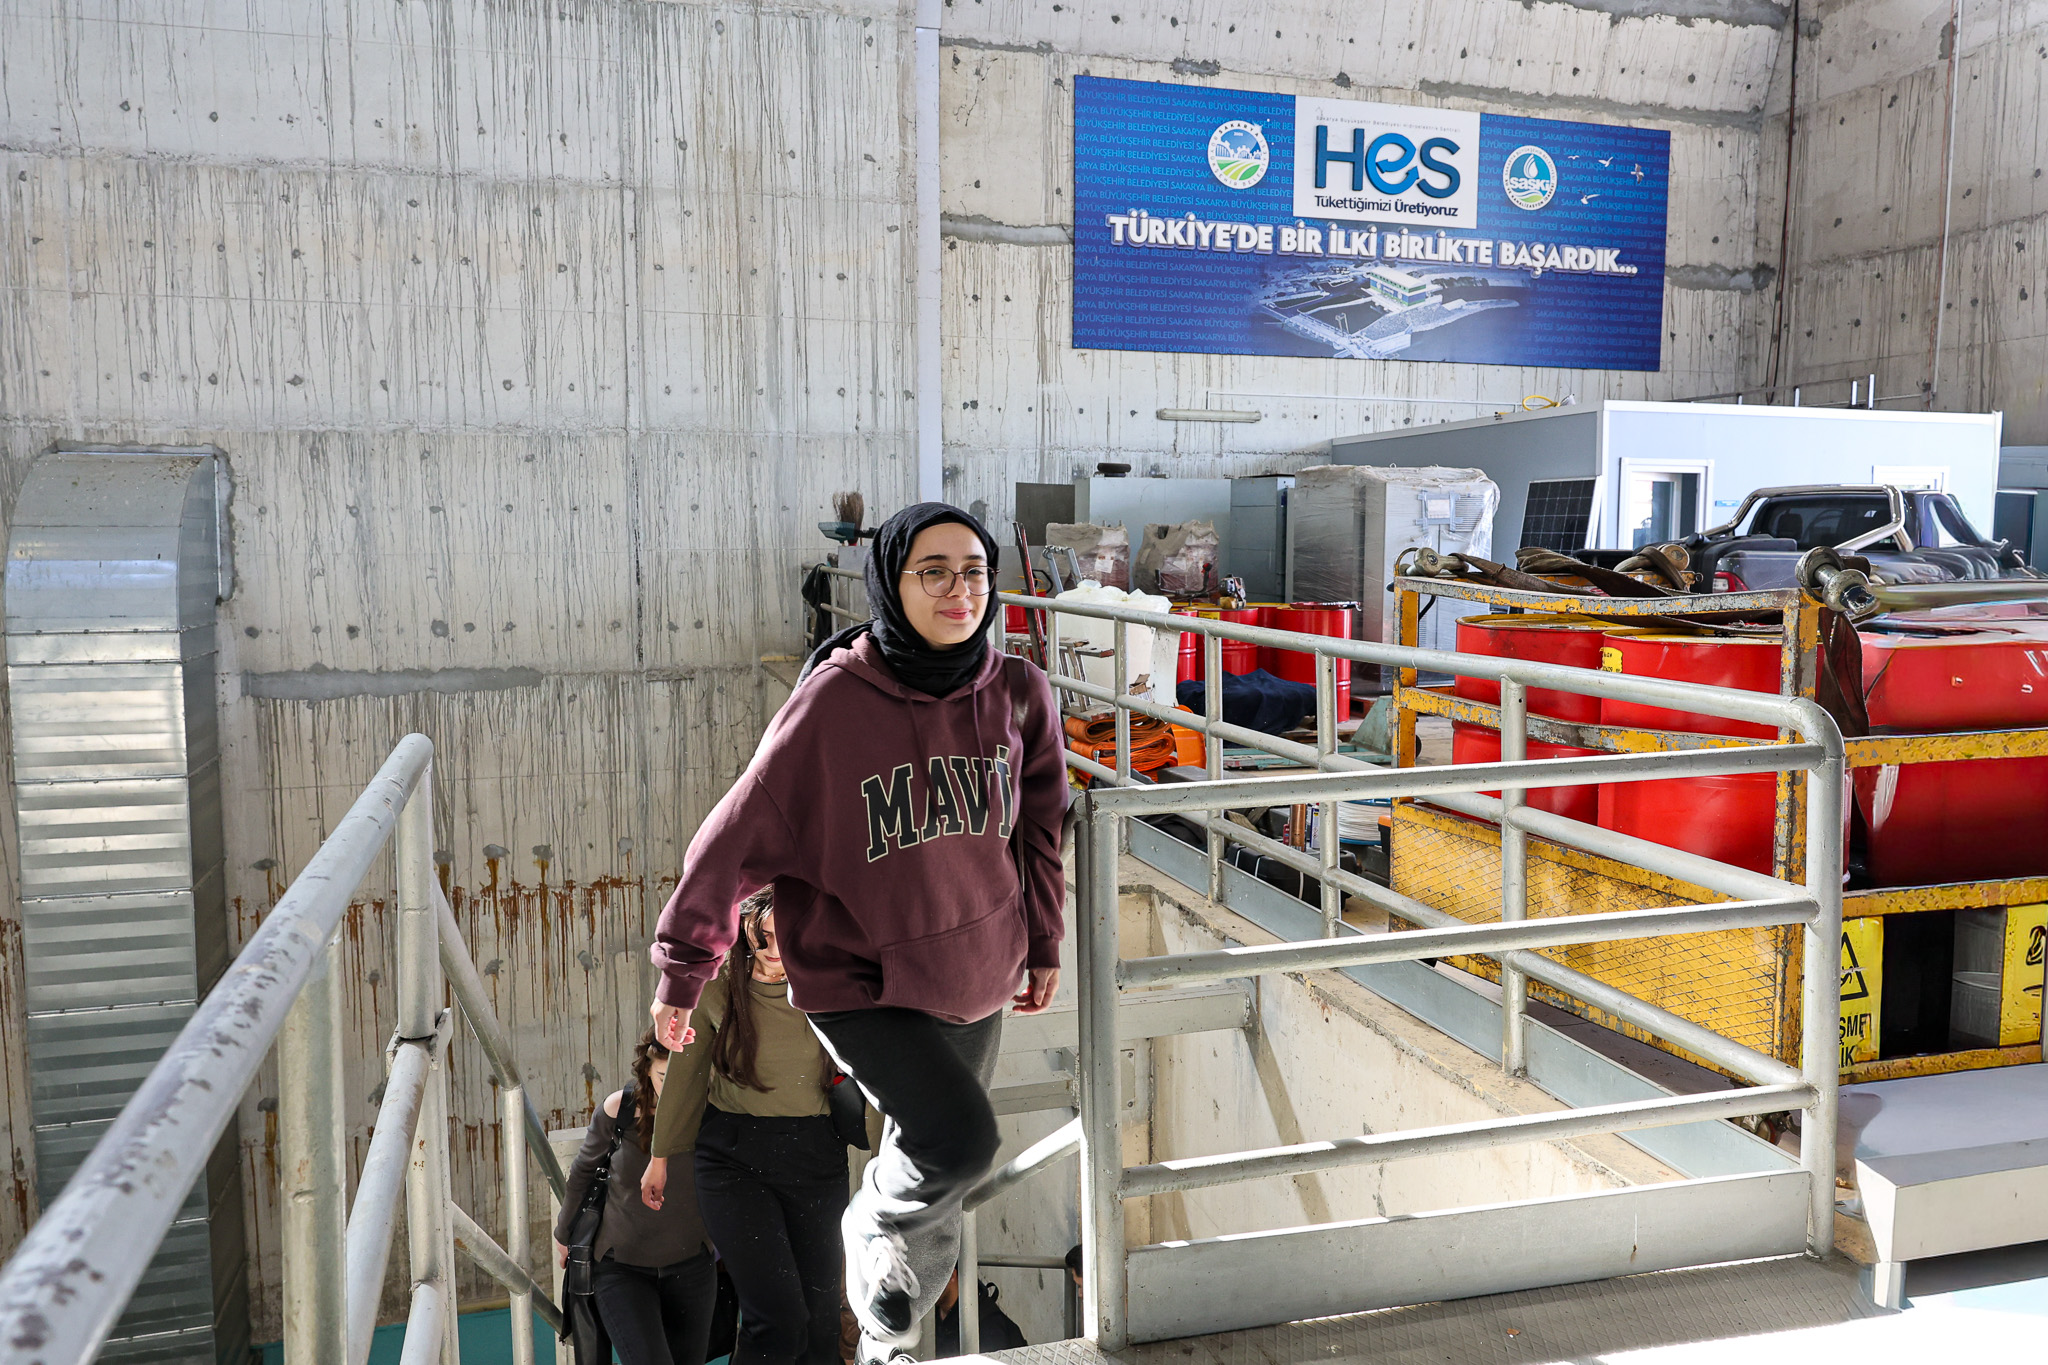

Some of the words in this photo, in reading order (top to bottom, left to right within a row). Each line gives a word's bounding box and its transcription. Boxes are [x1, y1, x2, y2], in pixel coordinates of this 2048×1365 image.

[1172, 98, 1206, 108] SAKARYA
[1172, 126, 1206, 136] SAKARYA
[1171, 153, 1205, 164] SAKARYA
[1171, 181, 1205, 191] SAKARYA
[1195, 197, 1229, 207] SAKARYA
[1314, 195, 1392, 212] Tükettiğimizi
[1394, 199, 1458, 216] Üretiyoruz
[1281, 220, 1323, 255] BİR
[1329, 222, 1377, 258] İLKİ
[1385, 227, 1494, 264] BİRLİKTE
[1497, 242, 1638, 278] BAŞARDIK...
[1194, 251, 1228, 260] SAKARYA
[1169, 262, 1203, 272] SAKARYA
[1193, 278, 1227, 288] SAKARYA
[1169, 290, 1202, 300] SAKARYA
[1193, 305, 1226, 314] SAKARYA
[1168, 317, 1202, 326] SAKARYA
[1192, 332, 1226, 341] SAKARYA
[861, 744, 1013, 863] MAVİ
